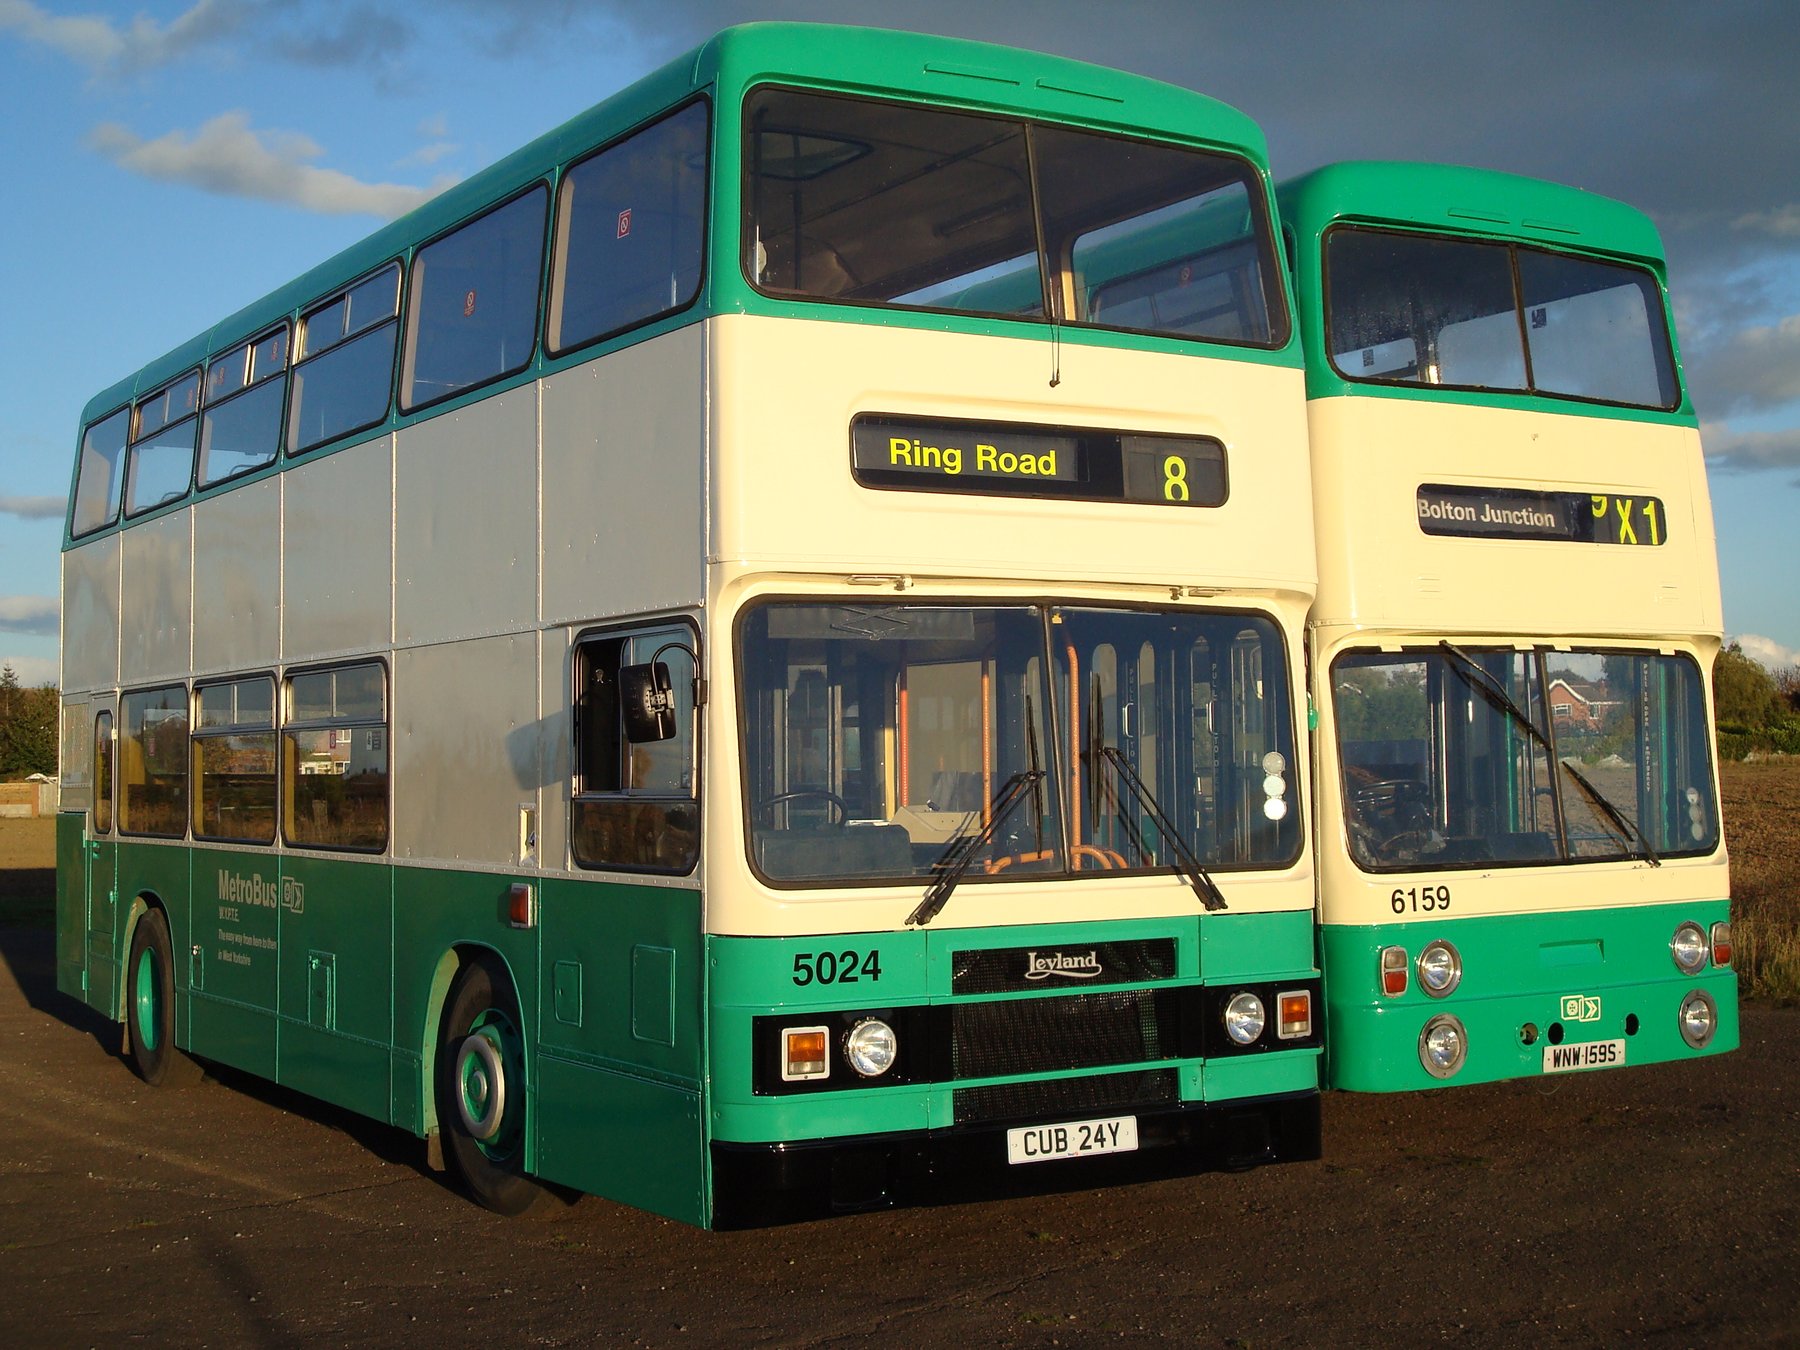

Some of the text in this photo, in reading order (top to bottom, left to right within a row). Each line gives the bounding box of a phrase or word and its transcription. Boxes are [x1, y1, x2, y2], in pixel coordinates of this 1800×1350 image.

[889, 438, 1057, 476] Ring Road
[1163, 455, 1190, 501] 8
[1418, 499, 1556, 528] Bolton Junction
[218, 869, 277, 909] MetroBus
[1391, 885, 1451, 914] 6159
[791, 950, 882, 987] 5024
[1024, 951, 1103, 980] Leyland
[1553, 1043, 1617, 1068] WNW 159S
[1023, 1122, 1120, 1156] CUB 24Y
